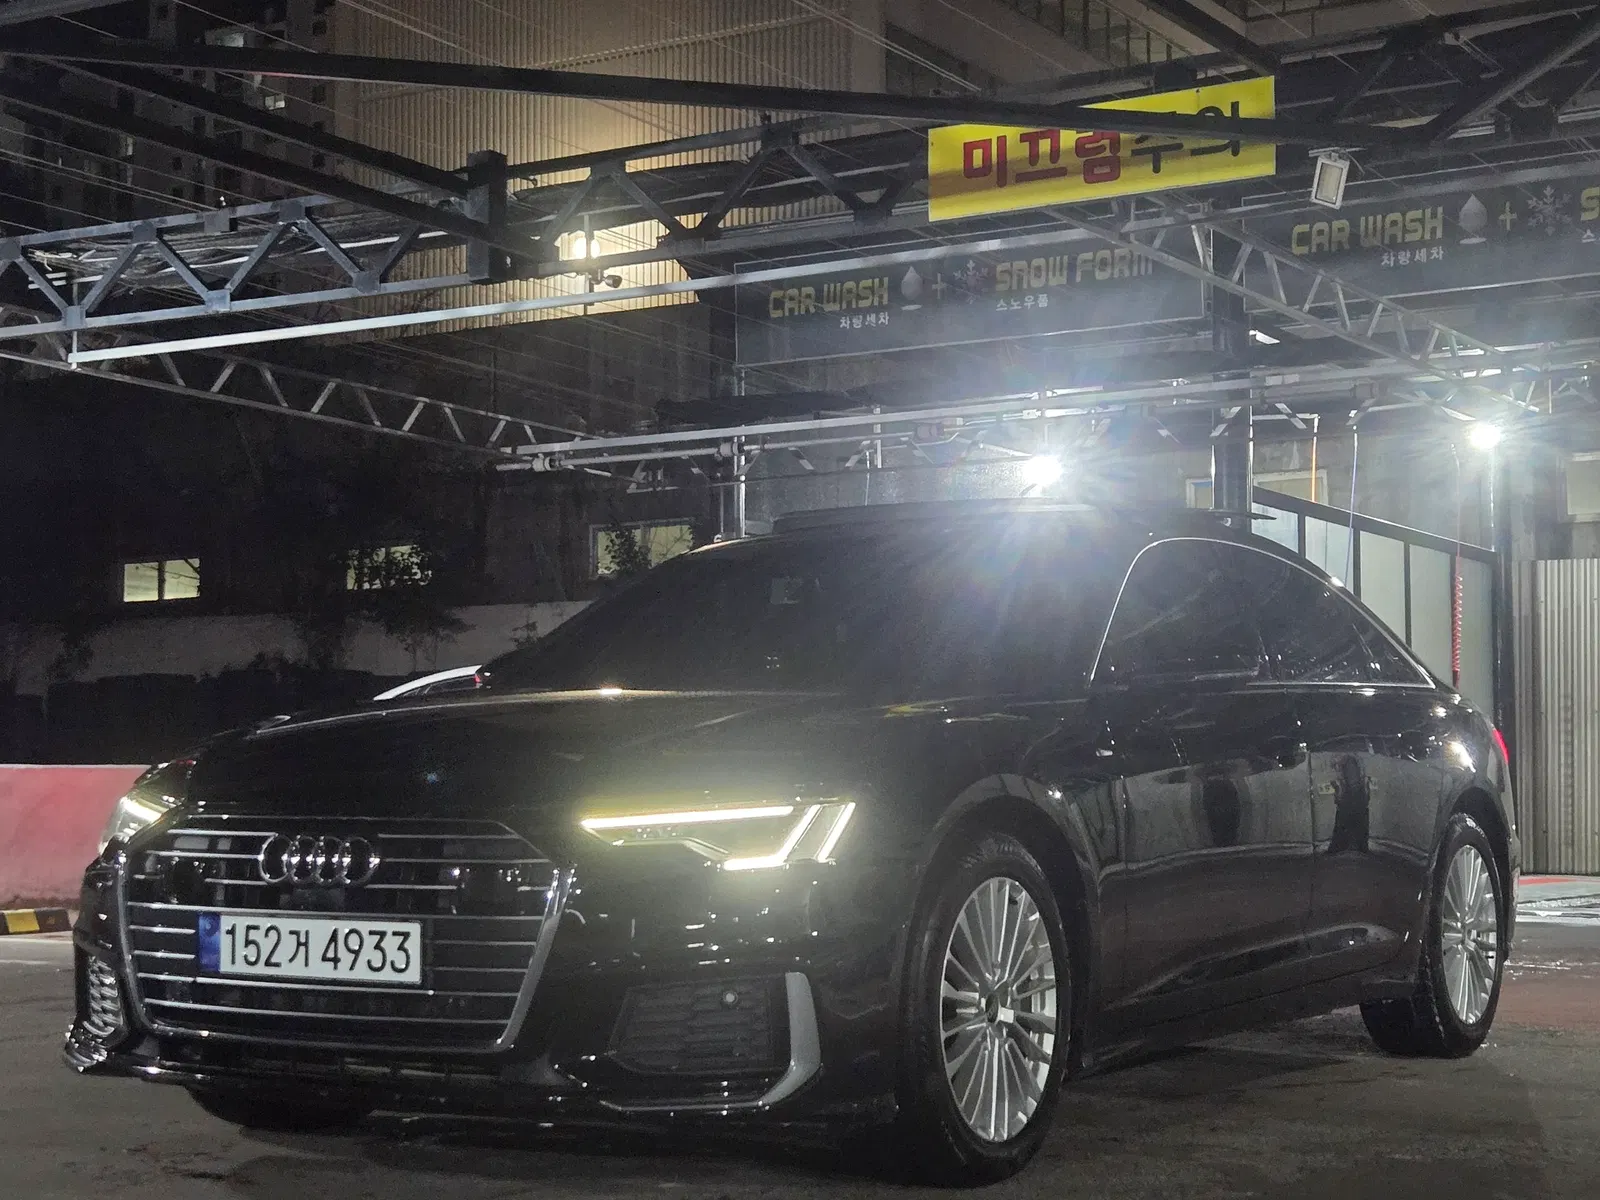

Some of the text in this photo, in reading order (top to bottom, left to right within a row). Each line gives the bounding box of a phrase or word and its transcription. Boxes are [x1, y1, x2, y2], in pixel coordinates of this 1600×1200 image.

[1291, 219, 1350, 256] CAR
[1360, 206, 1444, 248] WASH
[769, 248, 1153, 318] CAR WASH SNOW FORM
[225, 922, 412, 974] 152거 4933
